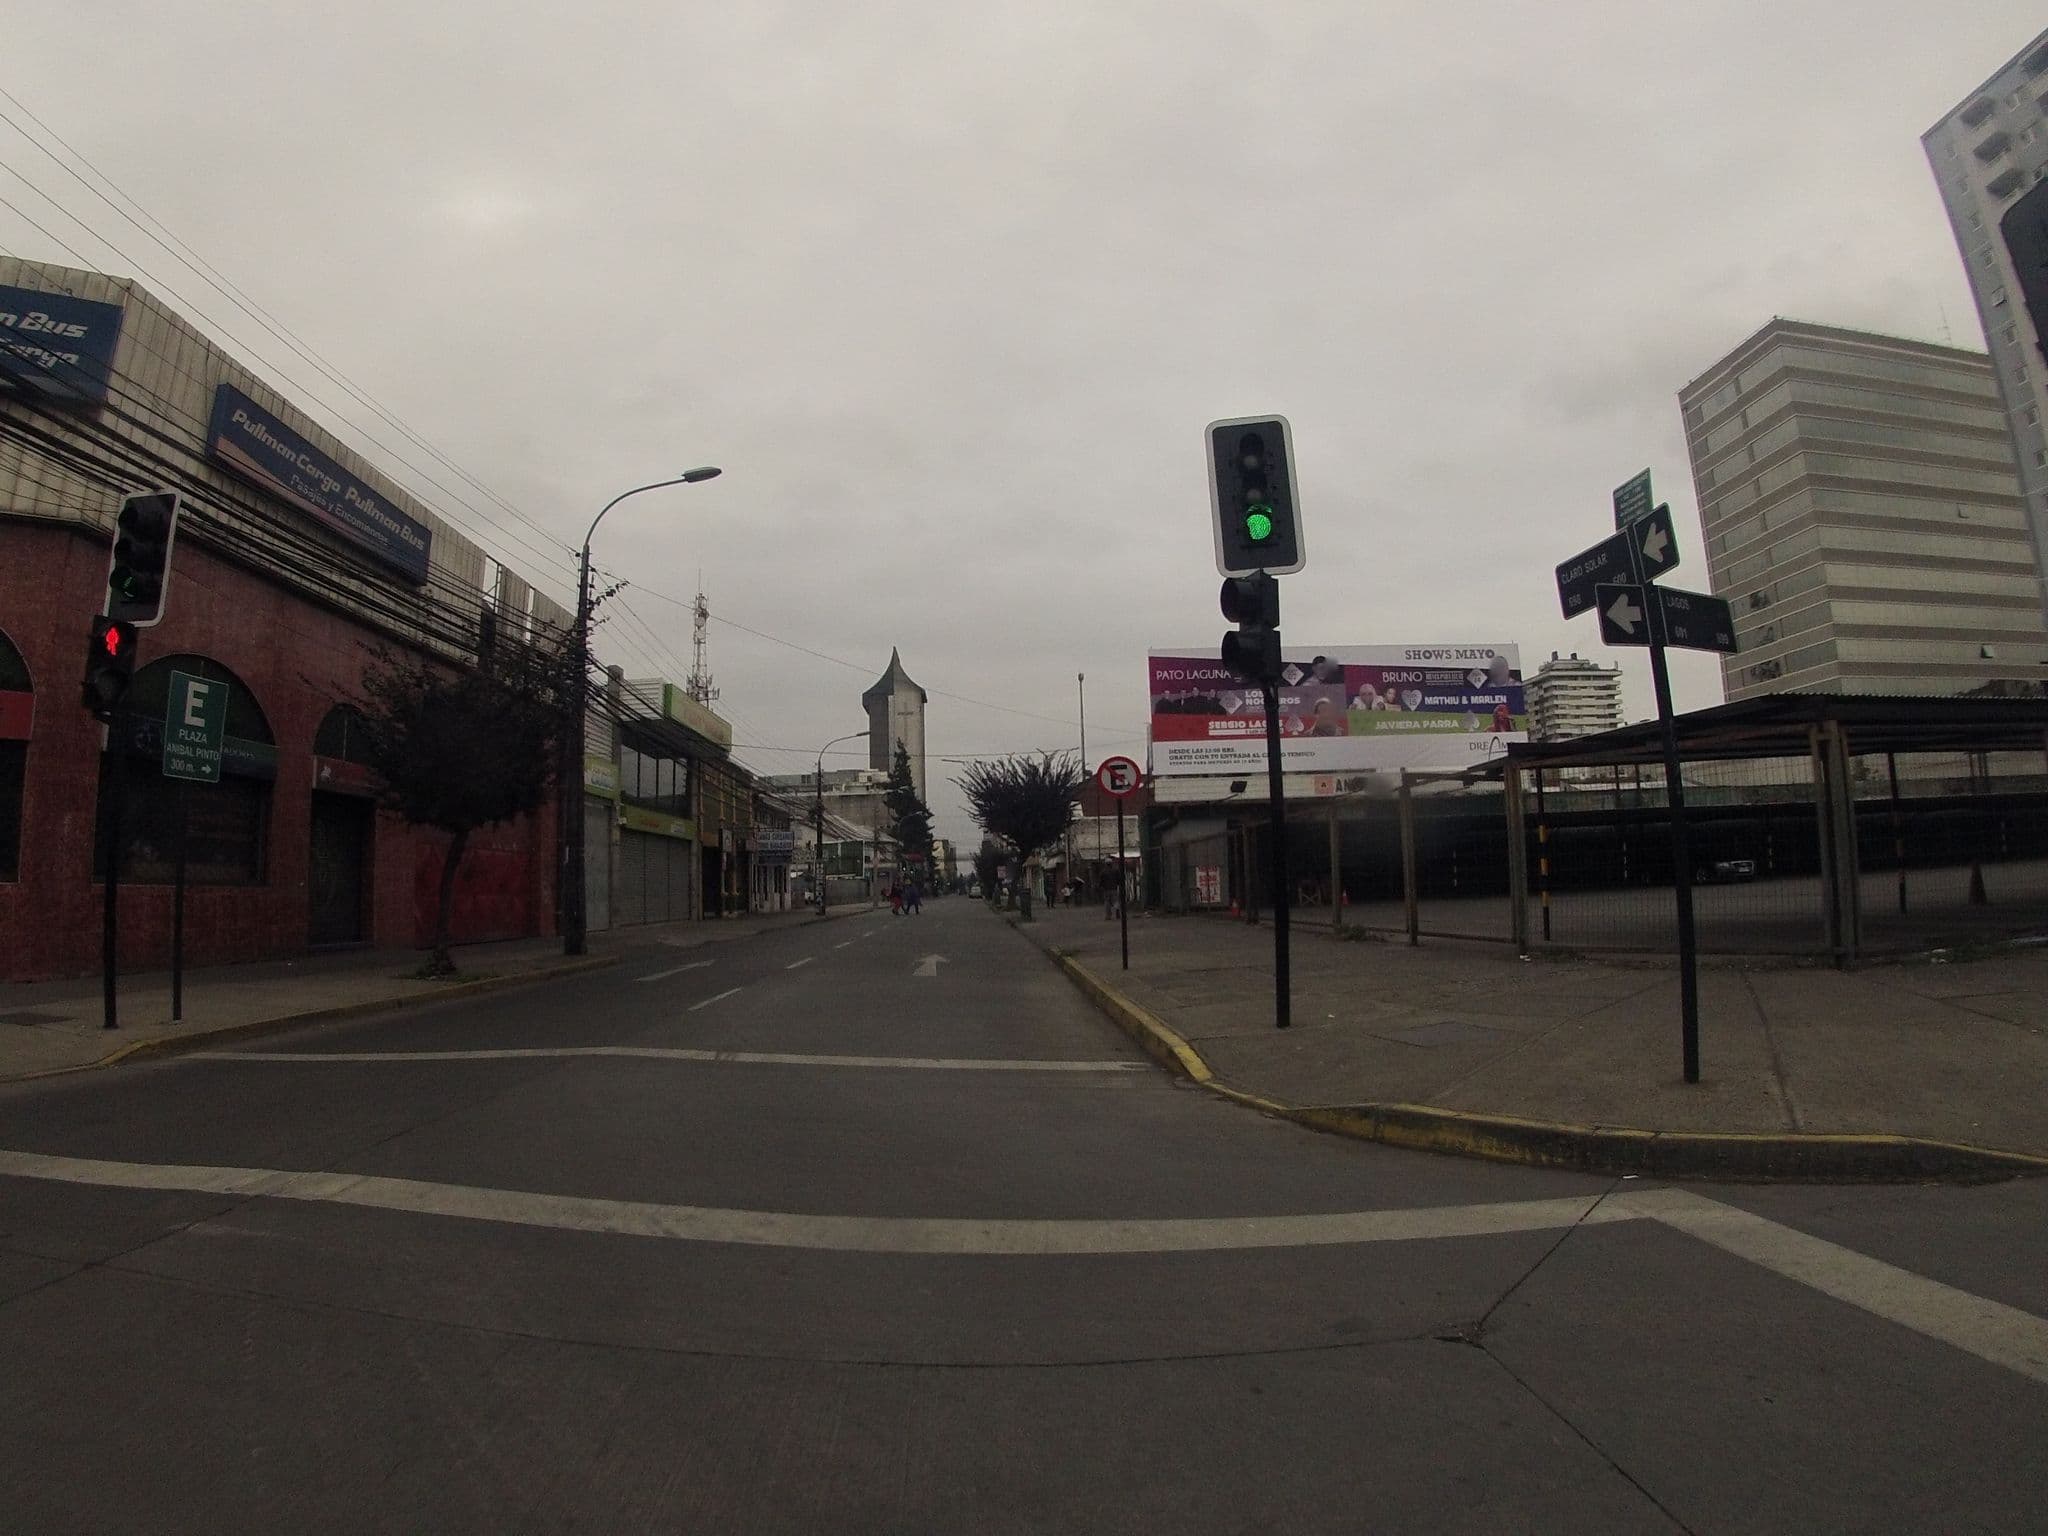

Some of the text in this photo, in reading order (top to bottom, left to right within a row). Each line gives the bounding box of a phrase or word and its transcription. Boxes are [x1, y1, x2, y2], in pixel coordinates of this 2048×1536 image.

[18, 311, 89, 338] Bus
[232, 408, 425, 551] Pullman Cargo Pullman Bus
[1562, 552, 1608, 585] CLARO SOLAR
[1405, 649, 1495, 660] SHOWS MAYO
[1156, 669, 1232, 680] PATO LAGUNA
[1382, 671, 1423, 682] BRUNO
[184, 681, 209, 728] E
[1470, 694, 1507, 705] MARLEN
[1208, 720, 1246, 729] SERGIO
[1375, 719, 1460, 730] JAVIERA PARRA
[178, 728, 208, 744] PLAZA
[195, 747, 220, 761] PINTO
[170, 758, 186, 772] 300
